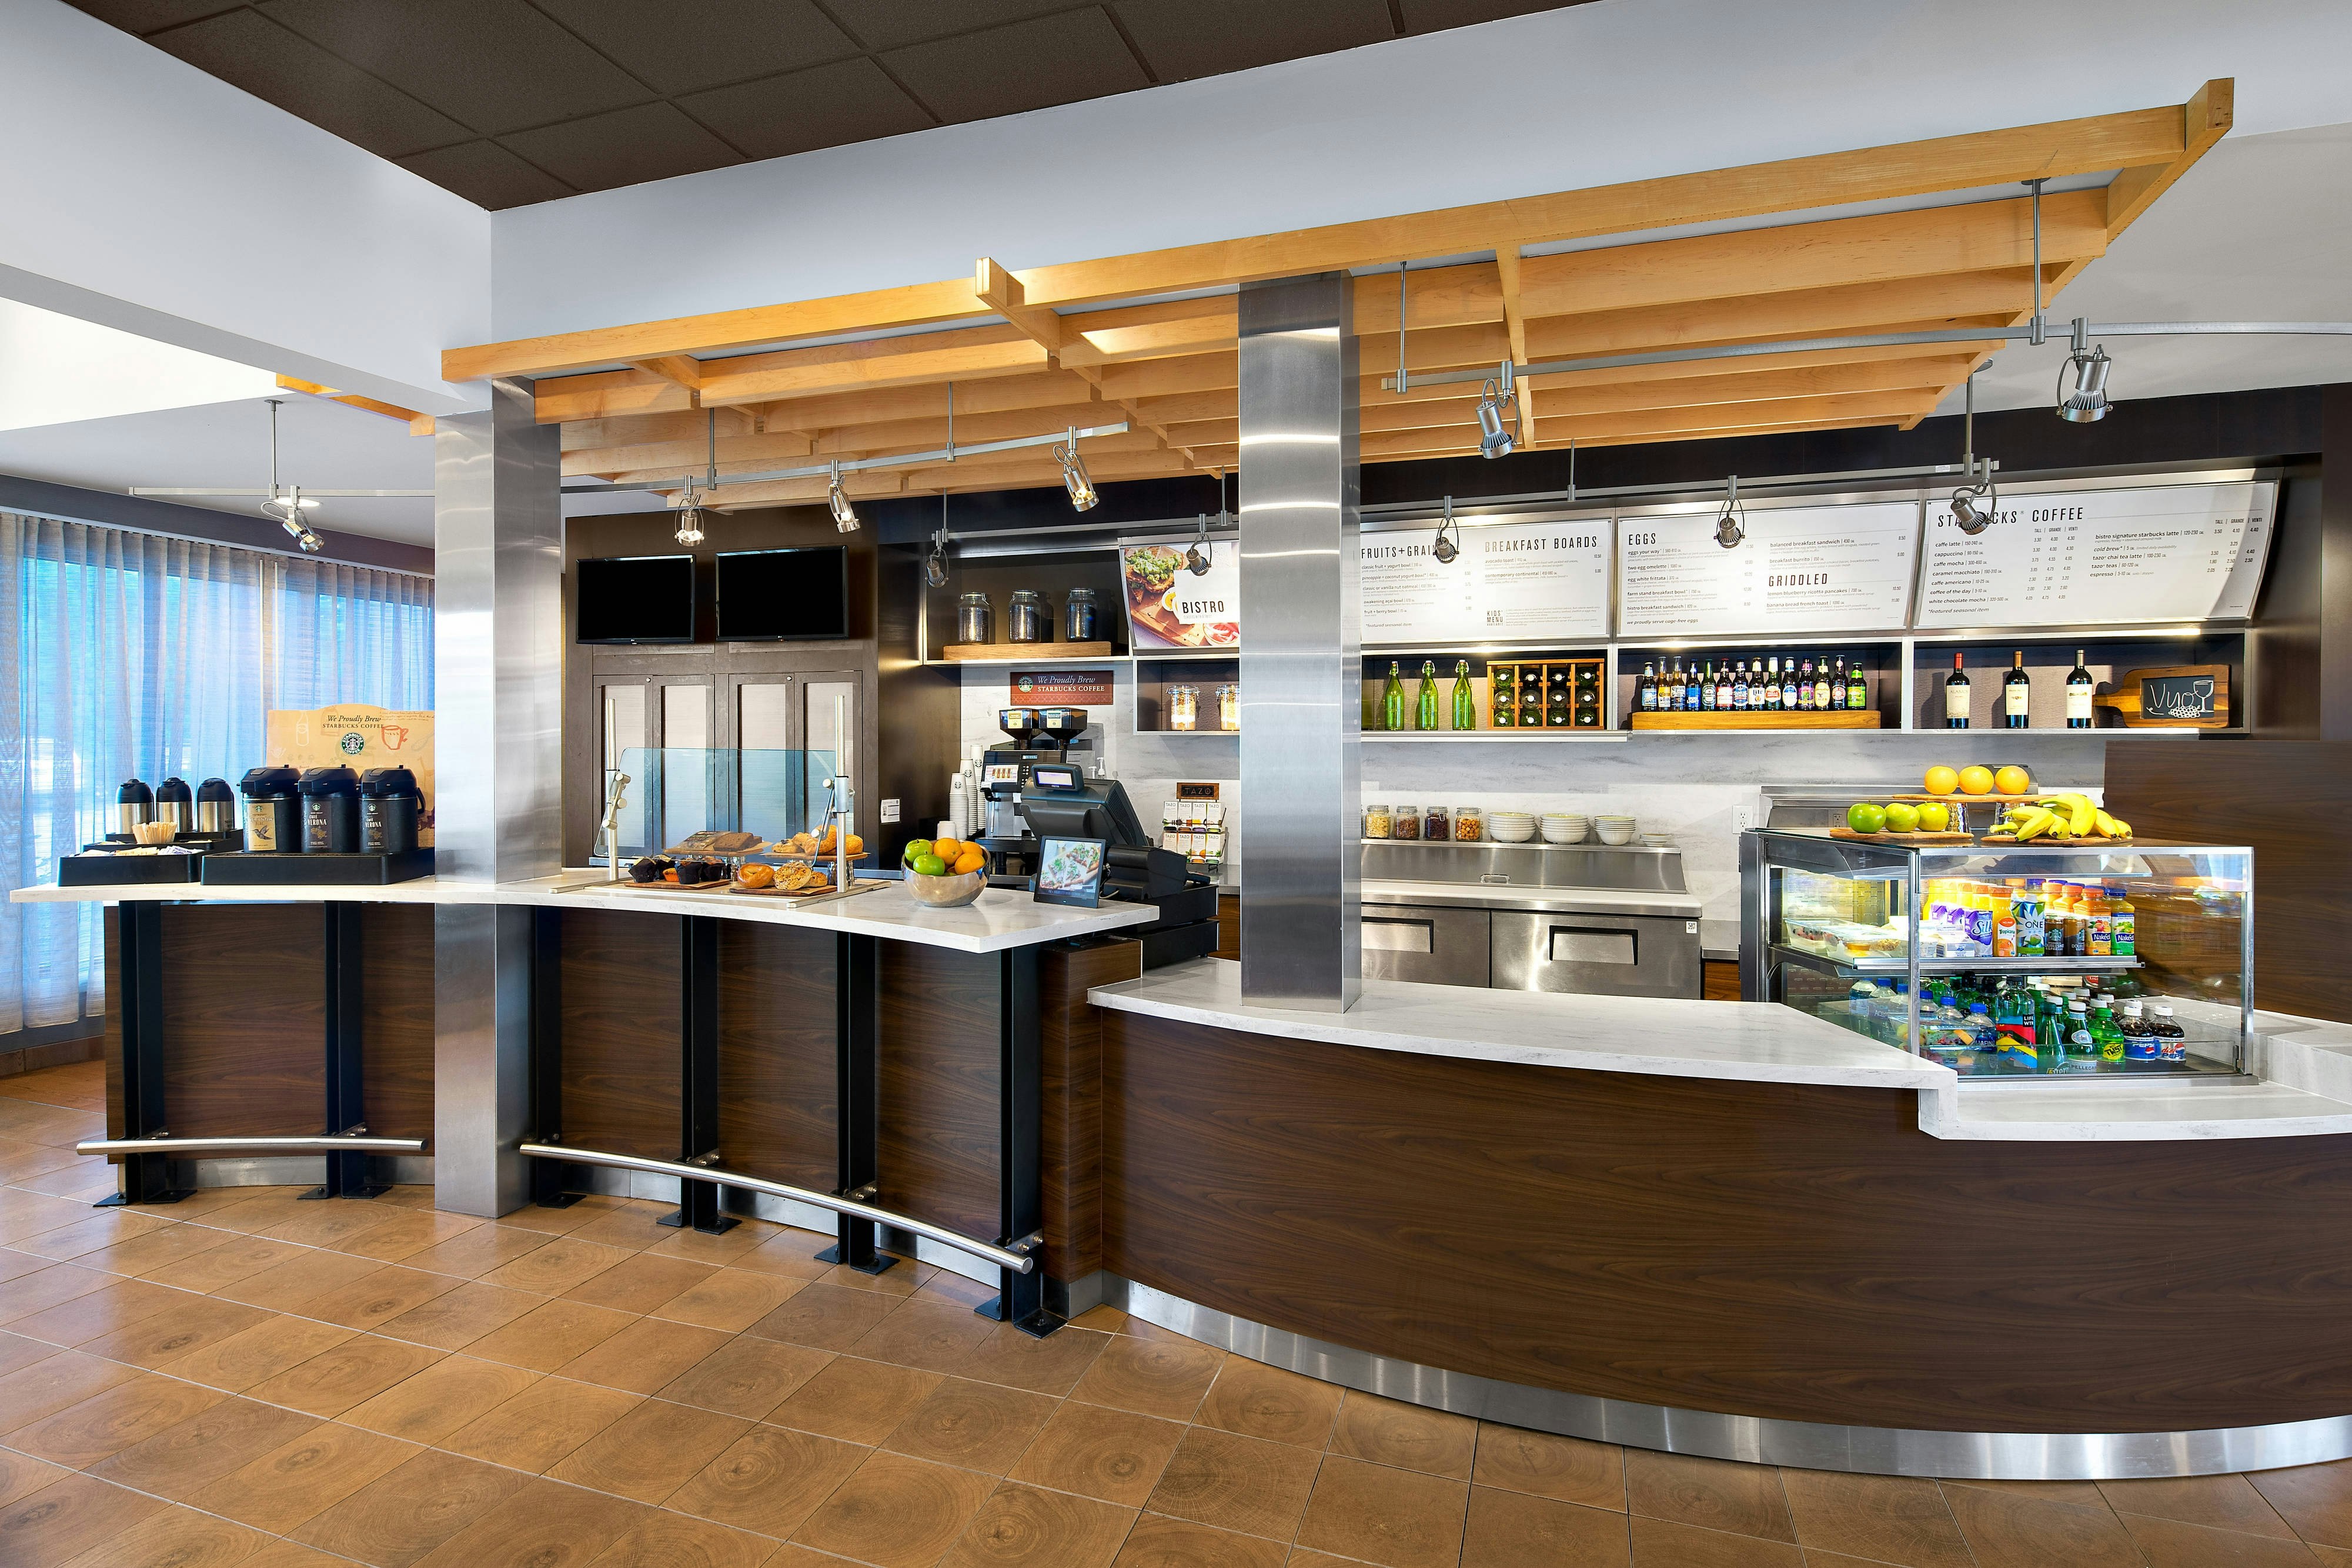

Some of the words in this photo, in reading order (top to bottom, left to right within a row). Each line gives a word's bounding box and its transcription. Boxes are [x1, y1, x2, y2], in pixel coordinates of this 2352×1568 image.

[1938, 511, 2017, 527] STACKS
[2032, 507, 2083, 522] COFFEE
[1486, 539, 1546, 552] BREAKFAST
[1554, 536, 1596, 549] BOARDS
[1629, 533, 1656, 545] EGGS
[1769, 574, 1827, 586] GRIDDLED
[1182, 601, 1224, 613] BISTRO
[1049, 676, 1075, 685] Proudly
[338, 715, 363, 723] Proudly
[342, 733, 364, 743] STARBUCKS
[1972, 920, 1992, 935] Silk
